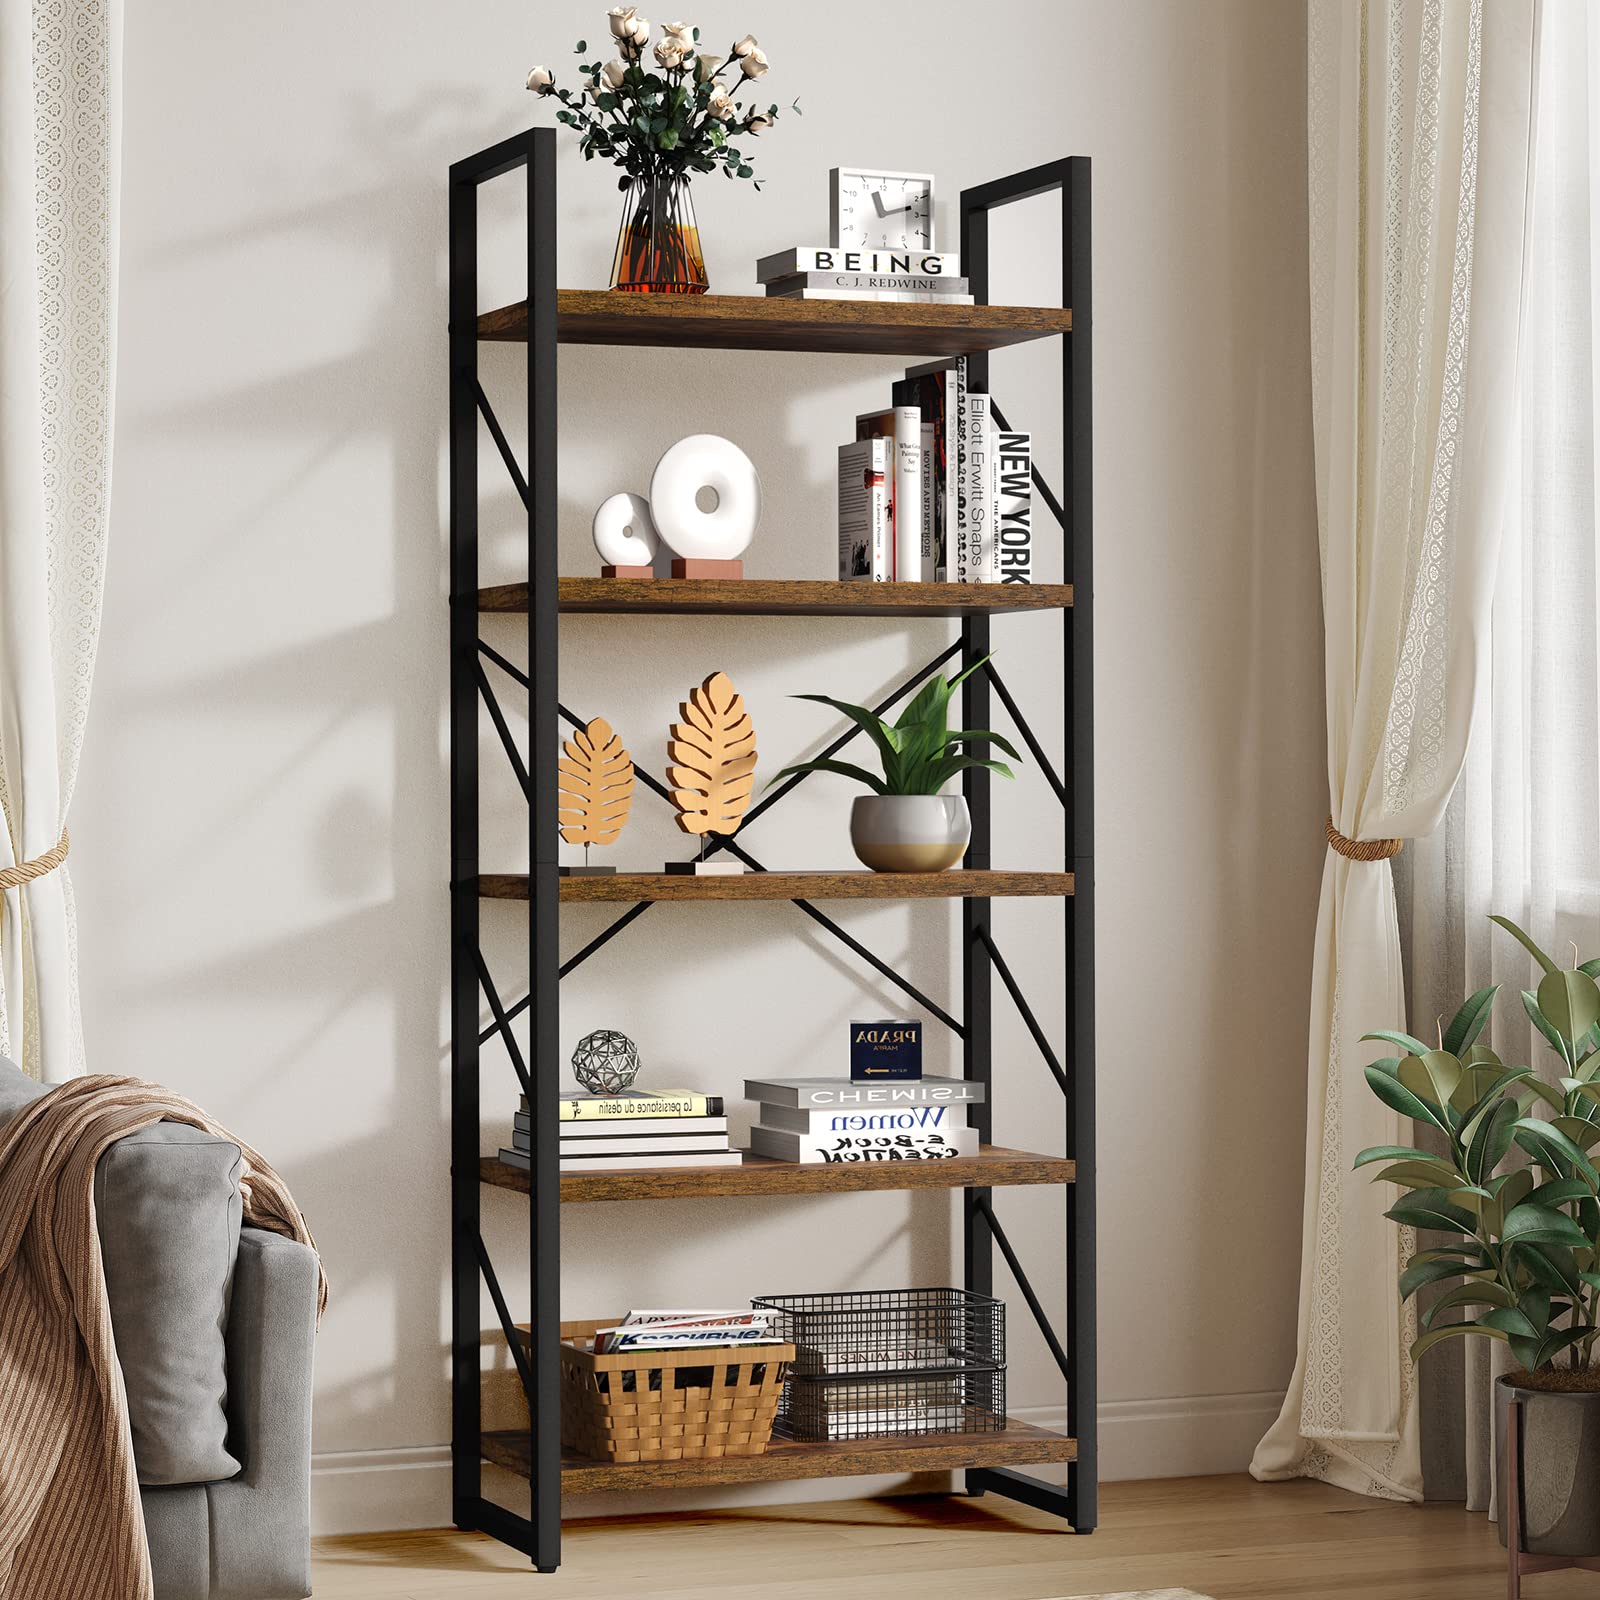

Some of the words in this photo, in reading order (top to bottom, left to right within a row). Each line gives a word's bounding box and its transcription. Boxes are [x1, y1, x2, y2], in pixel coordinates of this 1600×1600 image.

[815, 251, 942, 275] BEING
[836, 276, 848, 287] C.
[854, 277, 863, 287] J.
[869, 278, 937, 290] REDWINE
[971, 398, 984, 445] Elliott
[971, 452, 984, 501] Erwitt
[998, 434, 1030, 499] NEW
[969, 507, 985, 566] Snaps
[1000, 507, 1031, 584] YORK
